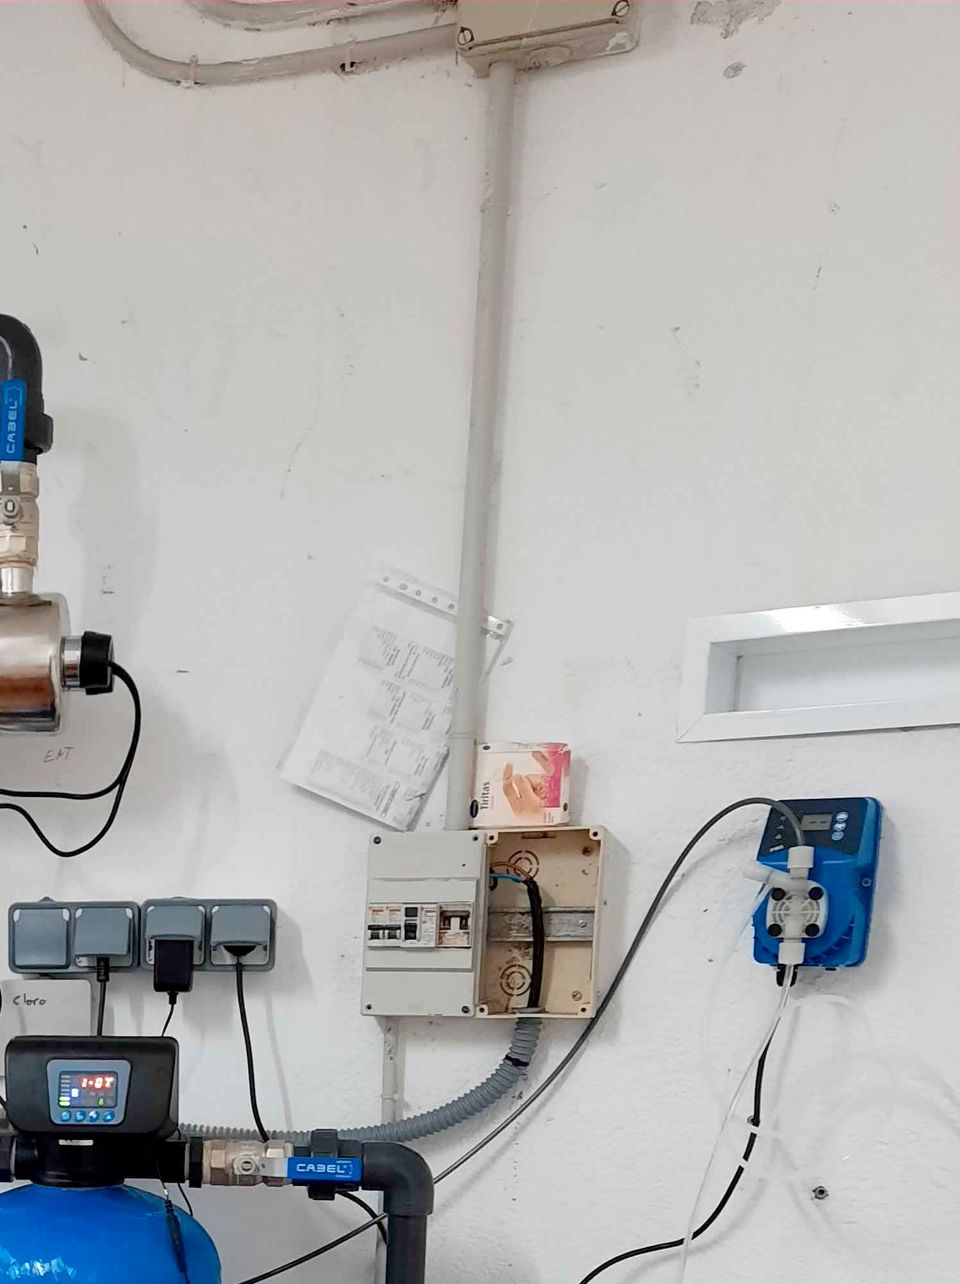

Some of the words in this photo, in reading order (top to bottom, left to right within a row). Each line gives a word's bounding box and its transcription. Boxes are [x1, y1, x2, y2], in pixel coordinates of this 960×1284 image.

[6, 400, 17, 454] CABEL
[480, 781, 490, 811] Tiritas
[296, 1163, 346, 1174] CABEL
